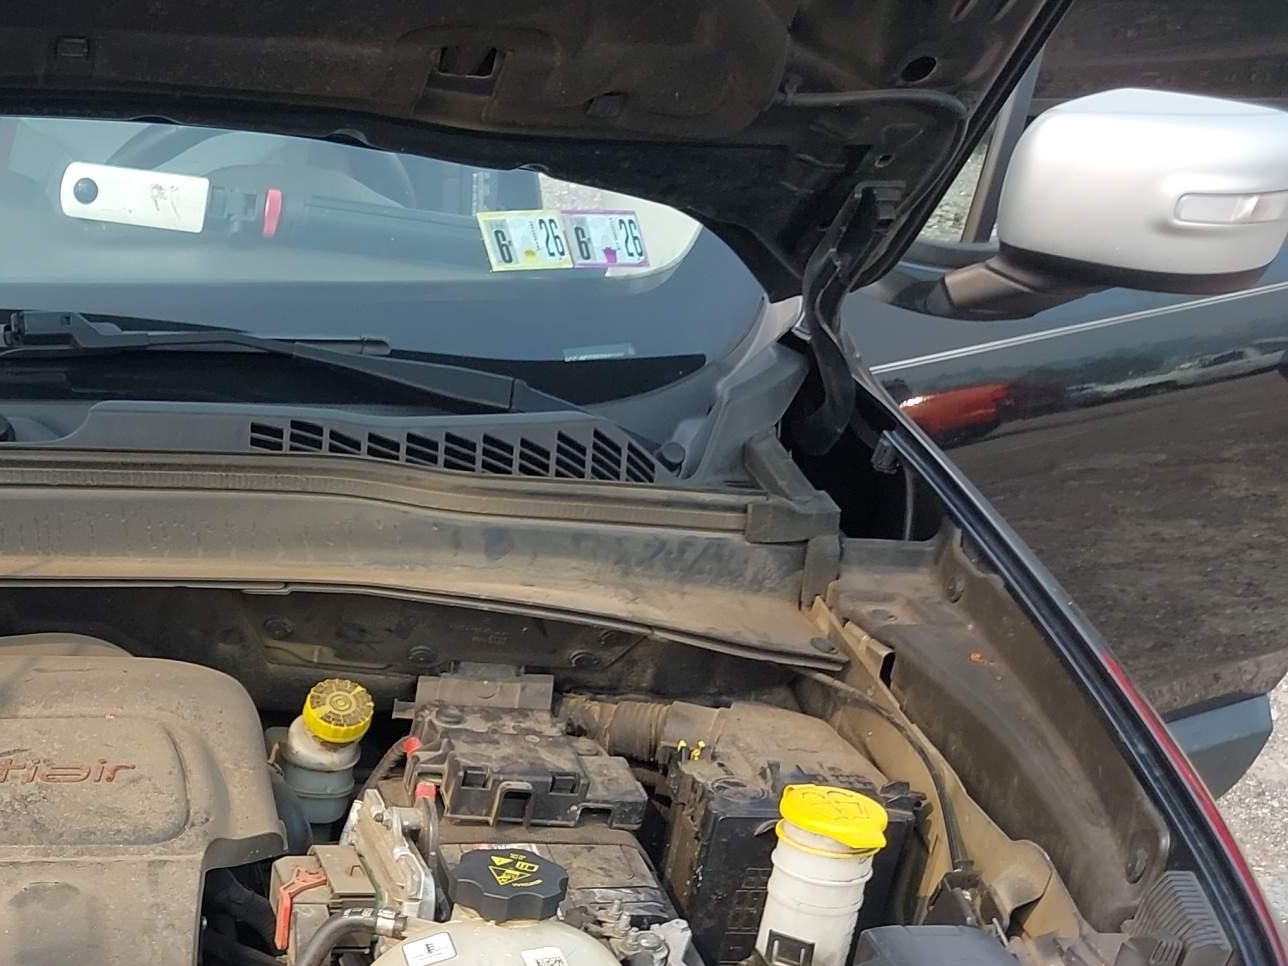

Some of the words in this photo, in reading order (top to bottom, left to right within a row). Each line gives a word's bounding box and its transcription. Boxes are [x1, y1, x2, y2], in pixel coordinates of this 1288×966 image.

[494, 229, 514, 263] 6
[538, 218, 565, 257] 26
[574, 226, 591, 260] 6
[618, 218, 644, 257] 26
